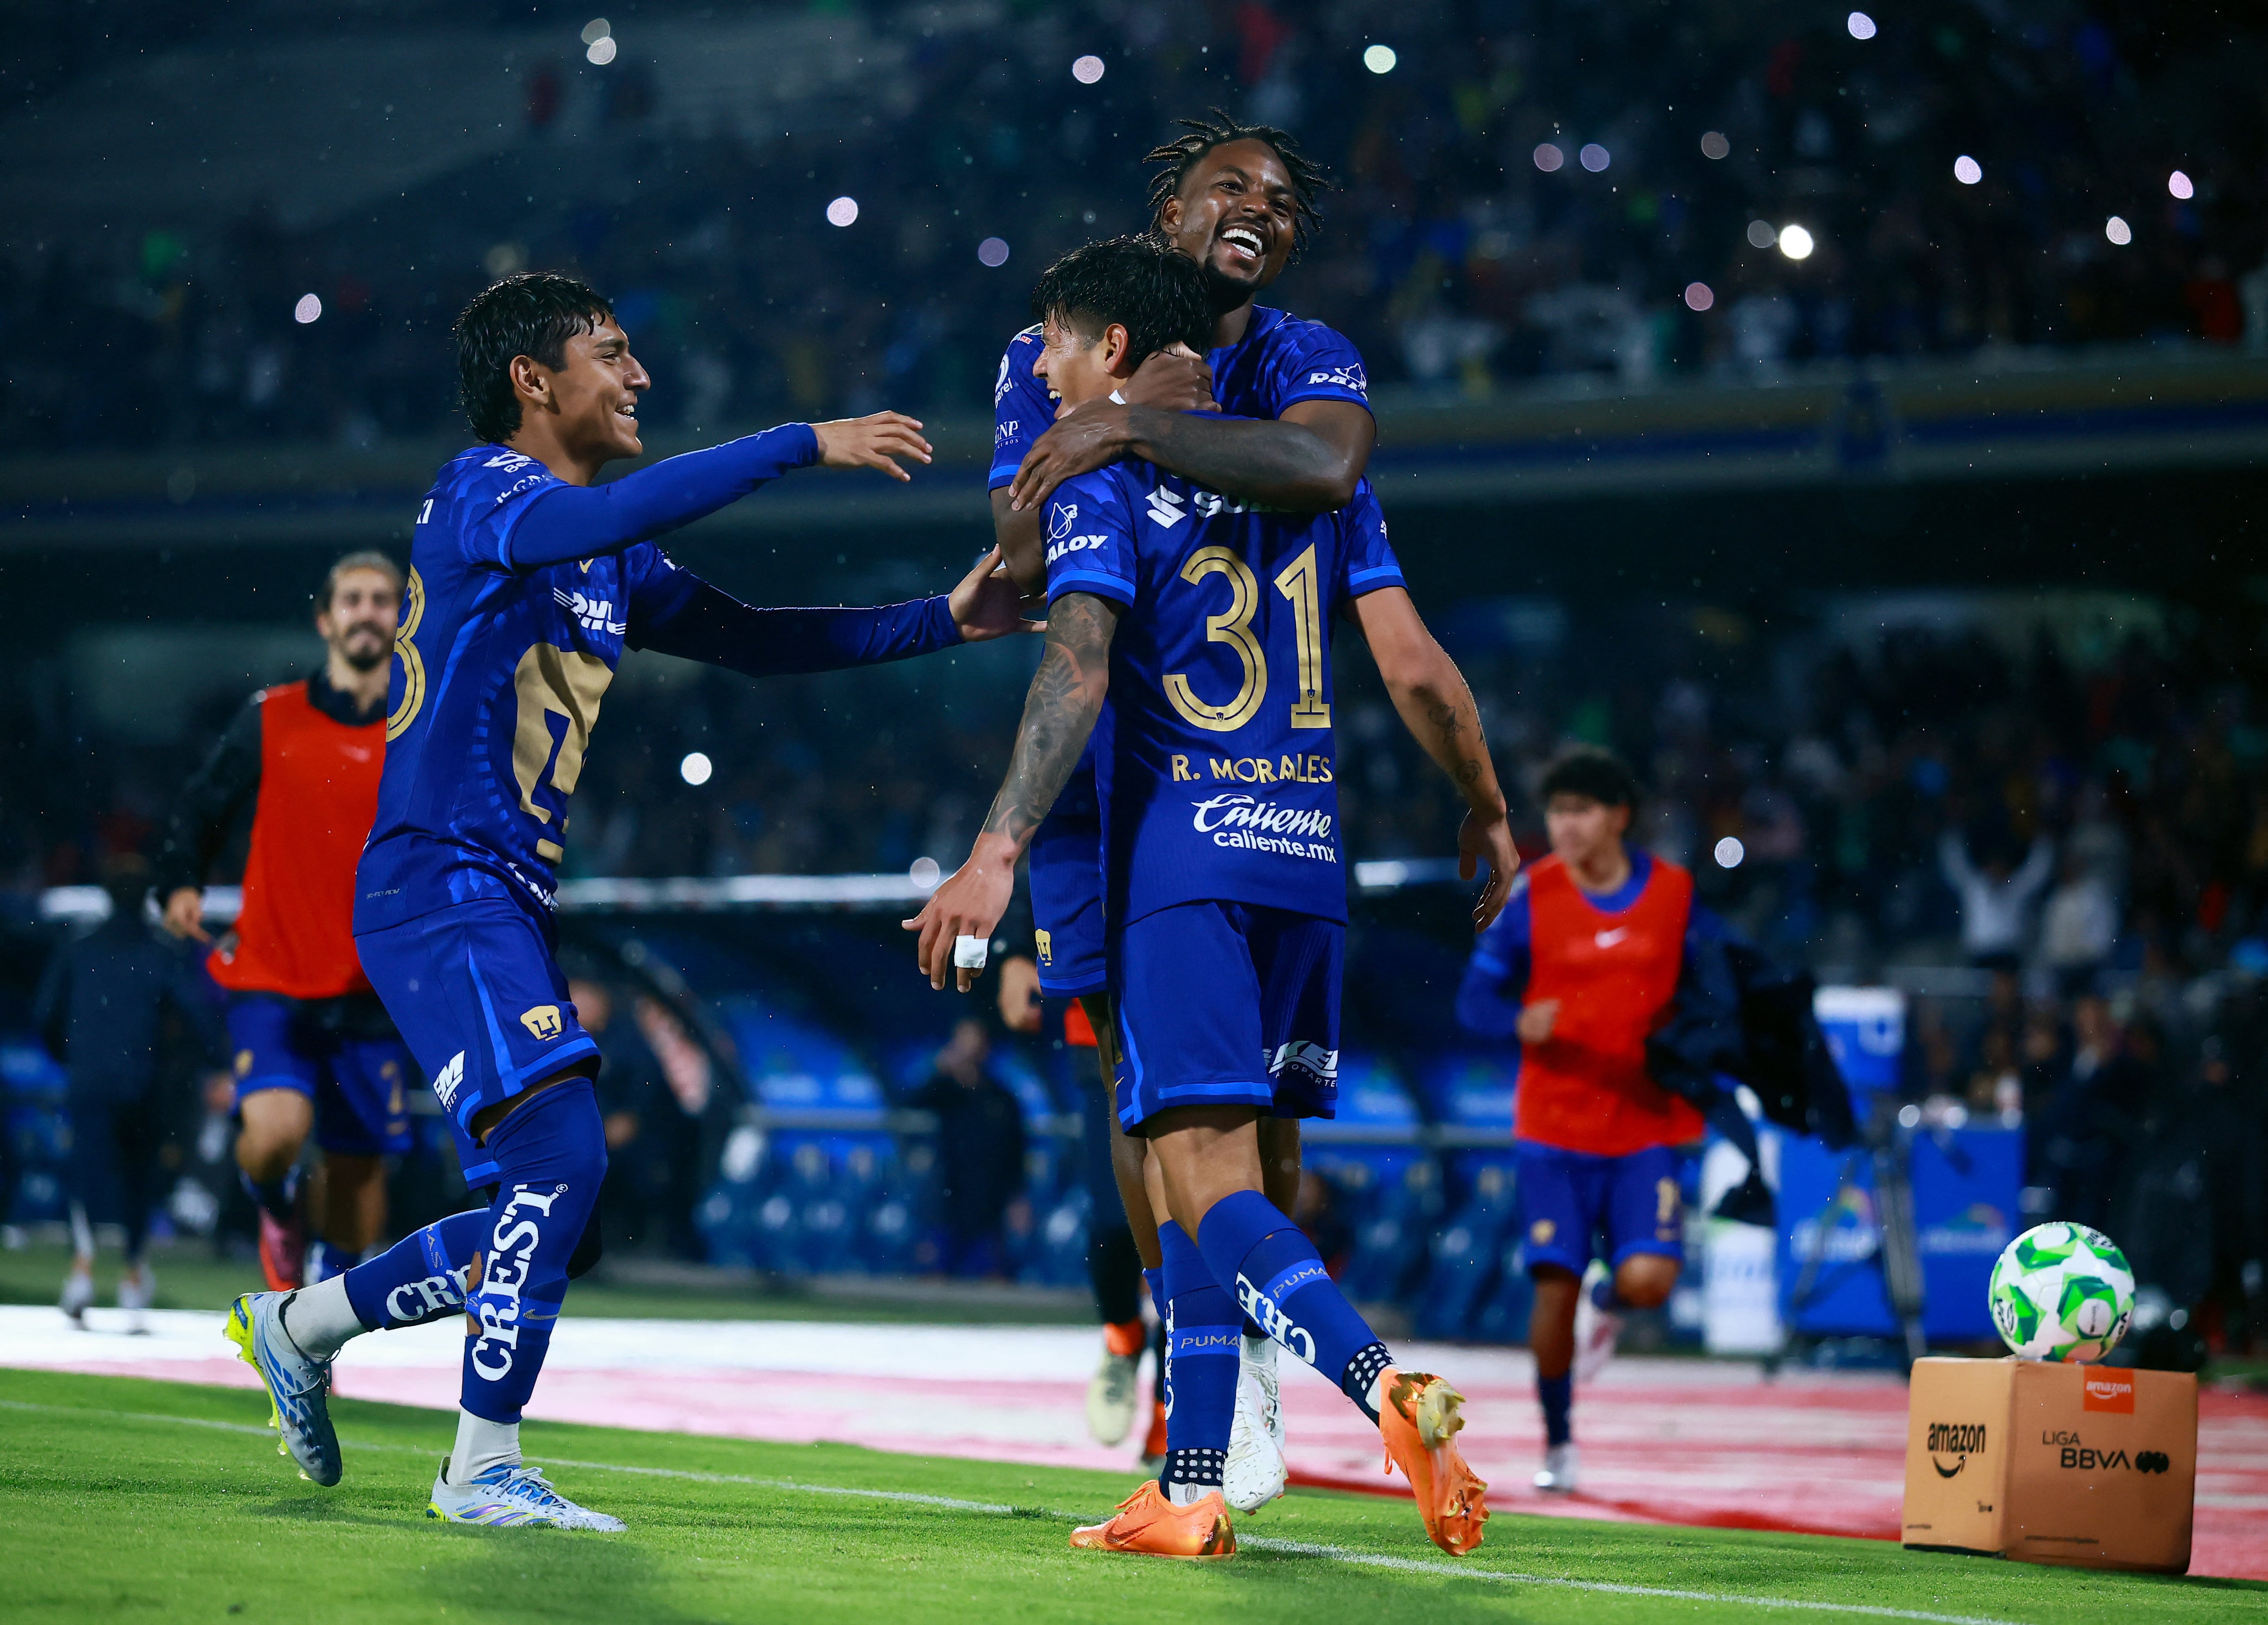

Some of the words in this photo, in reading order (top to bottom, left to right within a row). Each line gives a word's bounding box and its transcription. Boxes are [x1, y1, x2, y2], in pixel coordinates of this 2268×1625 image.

[1045, 535, 1108, 570] ALOY
[1162, 542, 1331, 732] 31
[1171, 755, 1201, 782] R.
[1210, 753, 1334, 783] MORALES
[1191, 793, 1331, 838] Caliente
[1213, 829, 1337, 863] caliente.mx
[1181, 1335, 1241, 1349] PUMA
[2087, 1380, 2132, 1393] amazon
[1927, 1422, 1986, 1454] amazon
[2042, 1430, 2081, 1446] LIGA
[2060, 1447, 2131, 1470] BBVA
